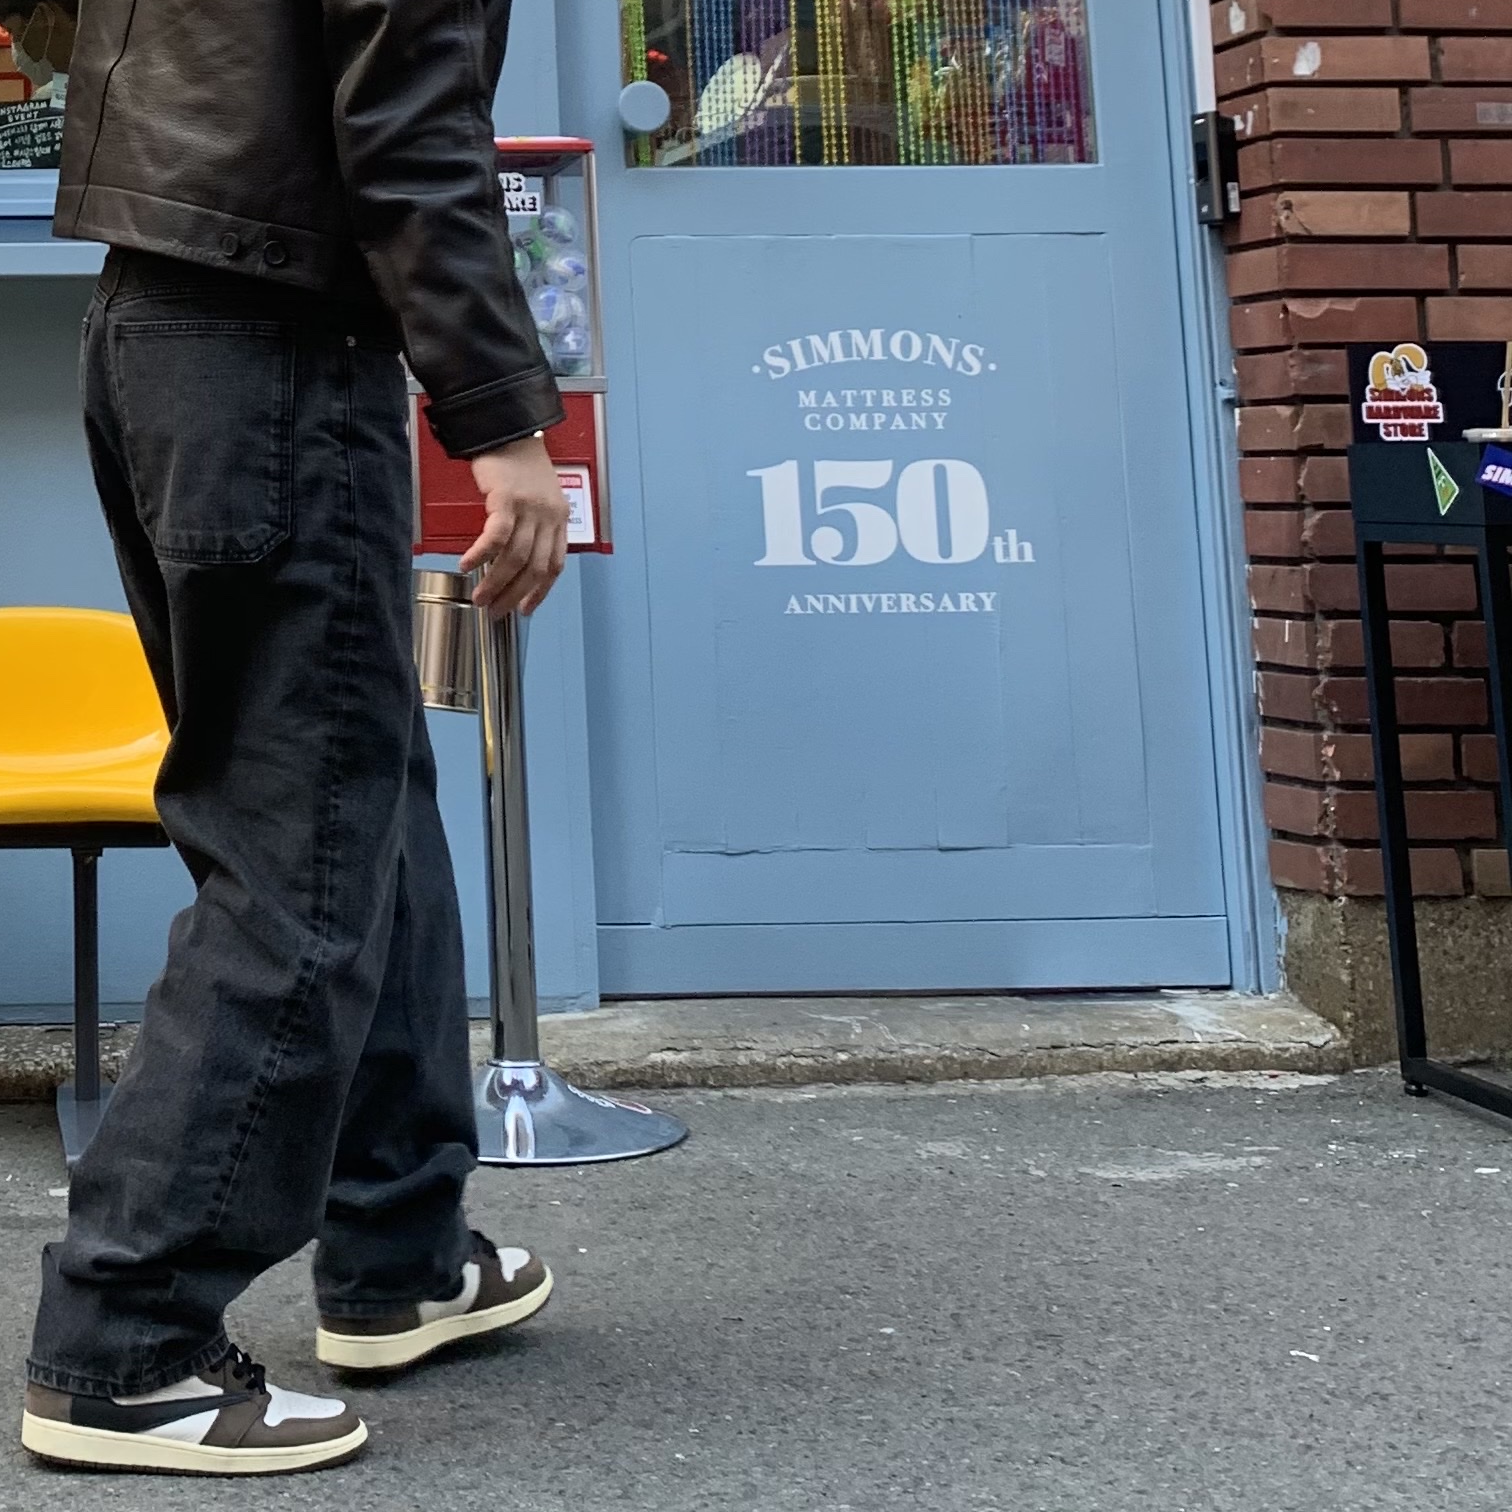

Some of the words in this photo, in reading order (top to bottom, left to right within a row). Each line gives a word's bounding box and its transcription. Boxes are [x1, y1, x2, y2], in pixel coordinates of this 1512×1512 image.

[8, 110, 39, 123] EVENT
[762, 328, 985, 380] SIMMONS
[799, 388, 952, 408] MATTRESS
[804, 412, 948, 431] COMPANY
[1383, 422, 1426, 438] STORE
[746, 459, 1036, 566] 150th
[784, 592, 998, 614] ANNIVERSARY
